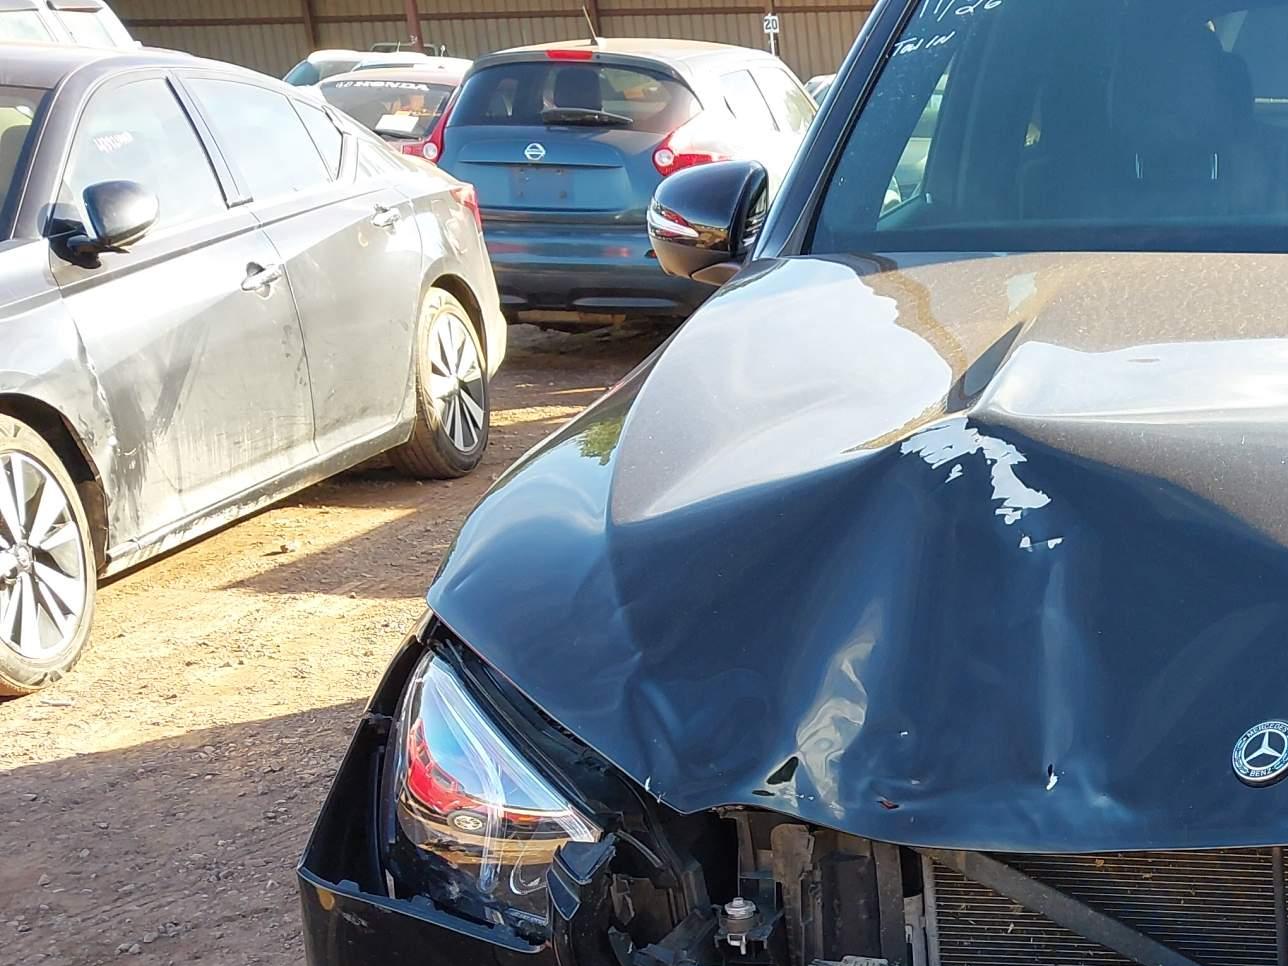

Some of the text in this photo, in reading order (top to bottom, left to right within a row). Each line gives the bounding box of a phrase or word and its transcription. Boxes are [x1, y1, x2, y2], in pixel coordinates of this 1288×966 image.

[764, 18, 778, 30] 20
[353, 80, 430, 92] HONDA
[1249, 767, 1273, 777] BENZ
